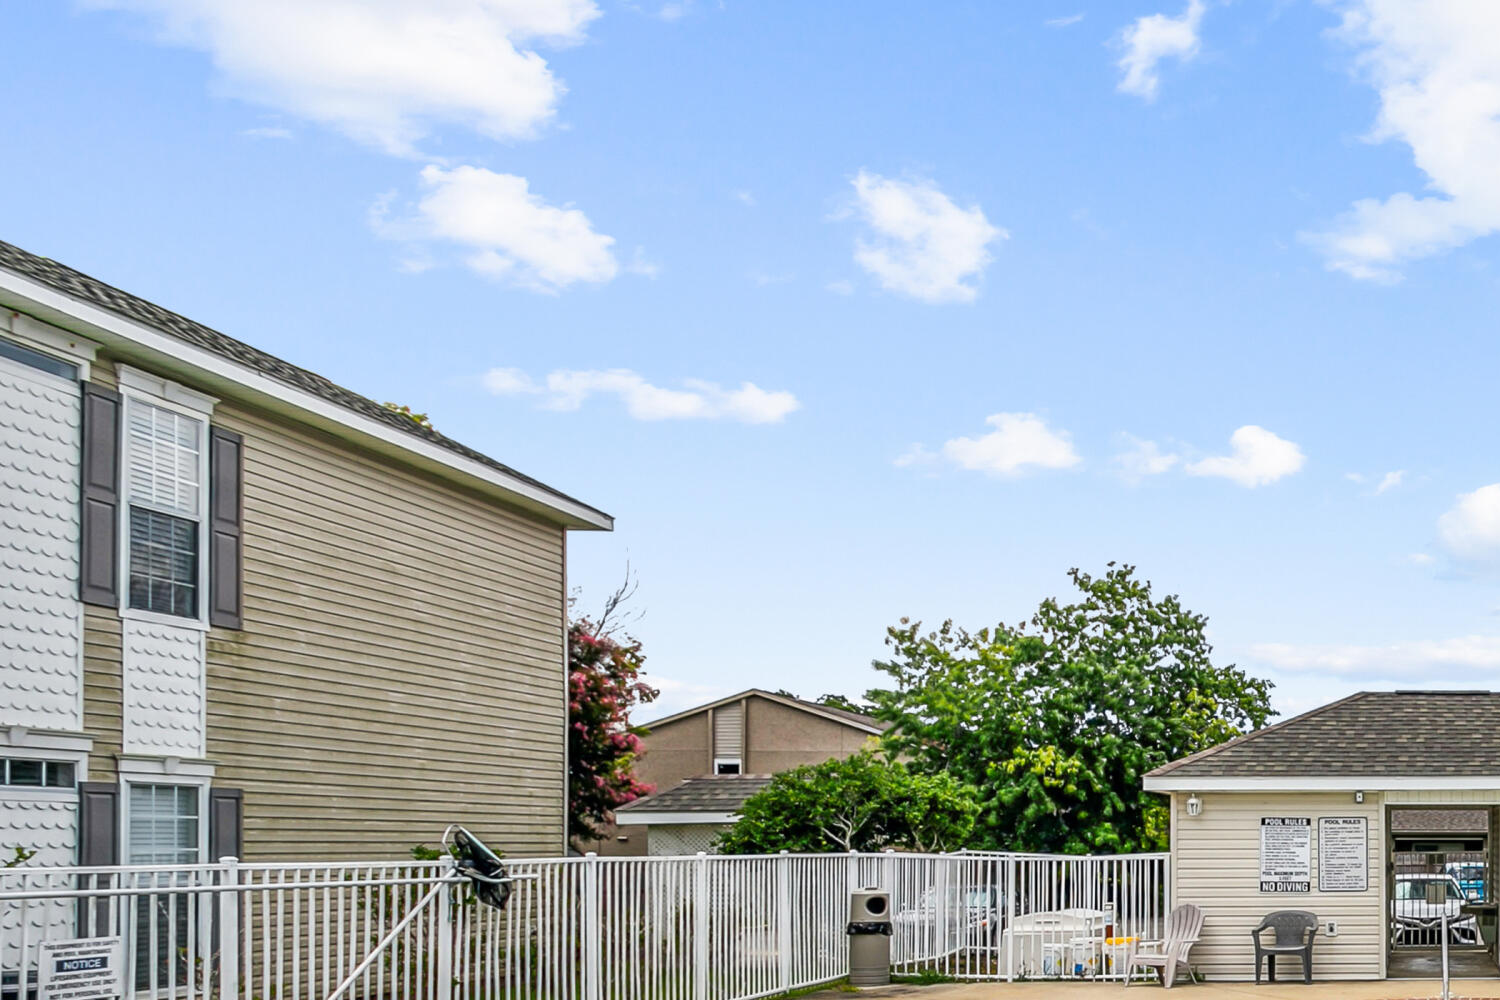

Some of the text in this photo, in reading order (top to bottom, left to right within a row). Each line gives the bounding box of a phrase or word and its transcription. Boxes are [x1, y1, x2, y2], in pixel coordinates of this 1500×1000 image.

[1265, 818, 1307, 826] POOL RULES
[1262, 881, 1309, 892] NO DIVING
[63, 958, 102, 970] NOTICE
